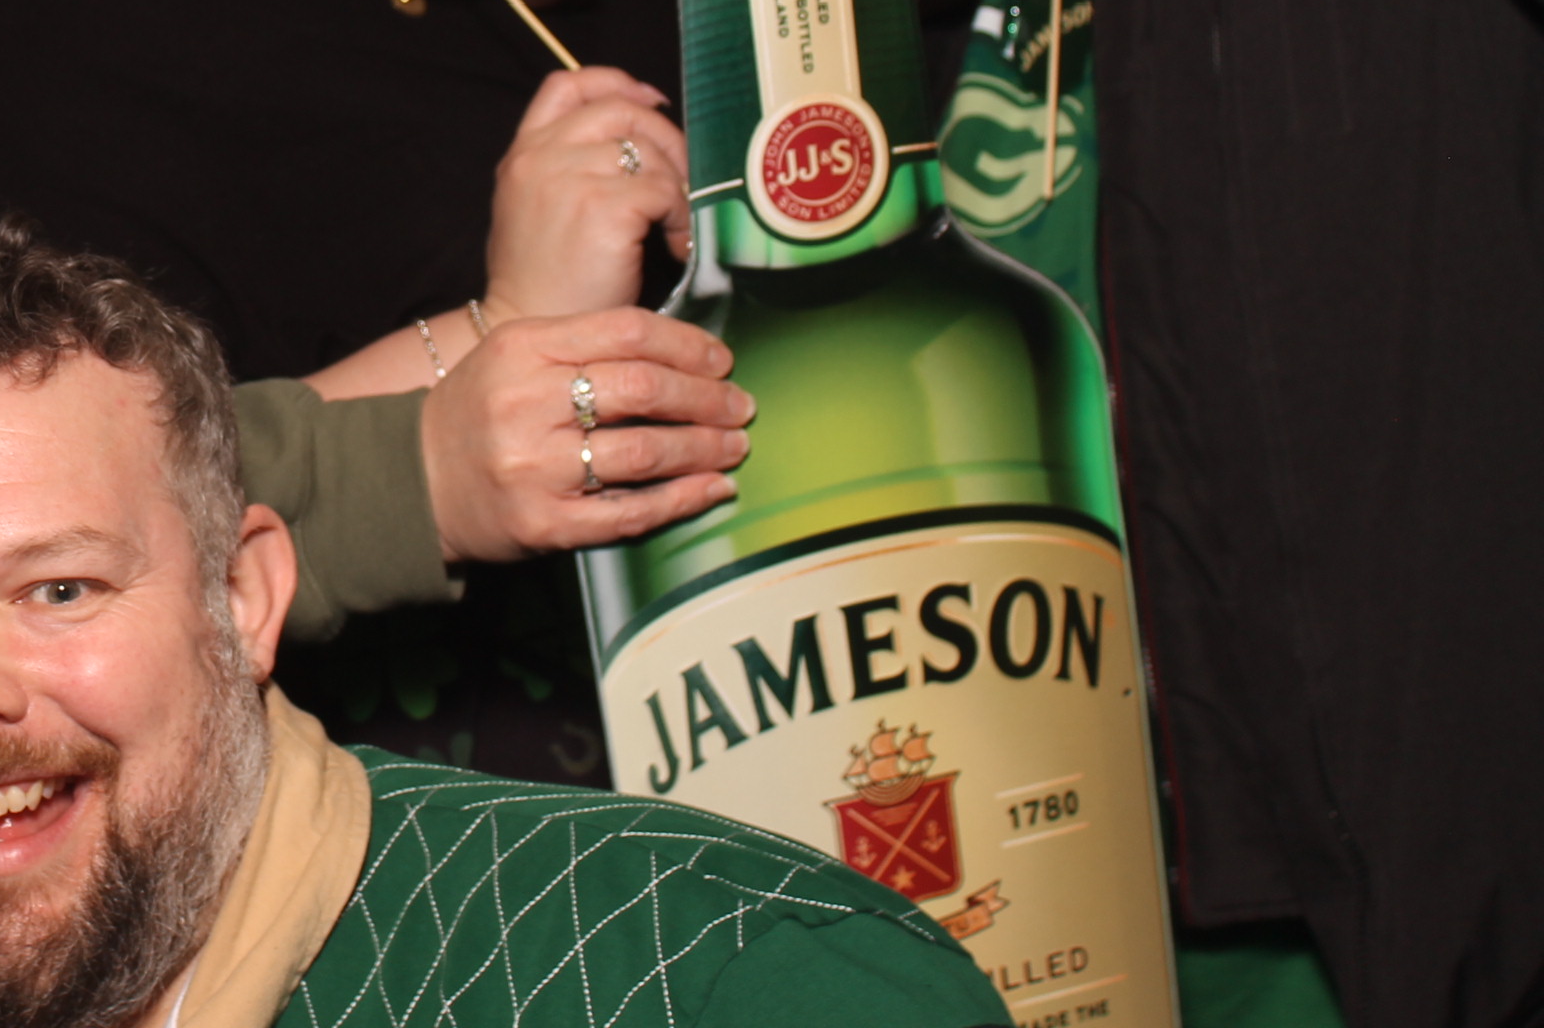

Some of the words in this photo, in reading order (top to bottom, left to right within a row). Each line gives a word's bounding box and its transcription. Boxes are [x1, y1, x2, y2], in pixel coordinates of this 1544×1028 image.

[765, 120, 794, 165] JOHN
[799, 105, 870, 148] JAMESON
[778, 195, 812, 220] SON
[817, 163, 872, 220] LIMITED
[645, 578, 1105, 796] JAMESON
[1008, 789, 1080, 831] 1780
[1076, 998, 1111, 1020] THE
